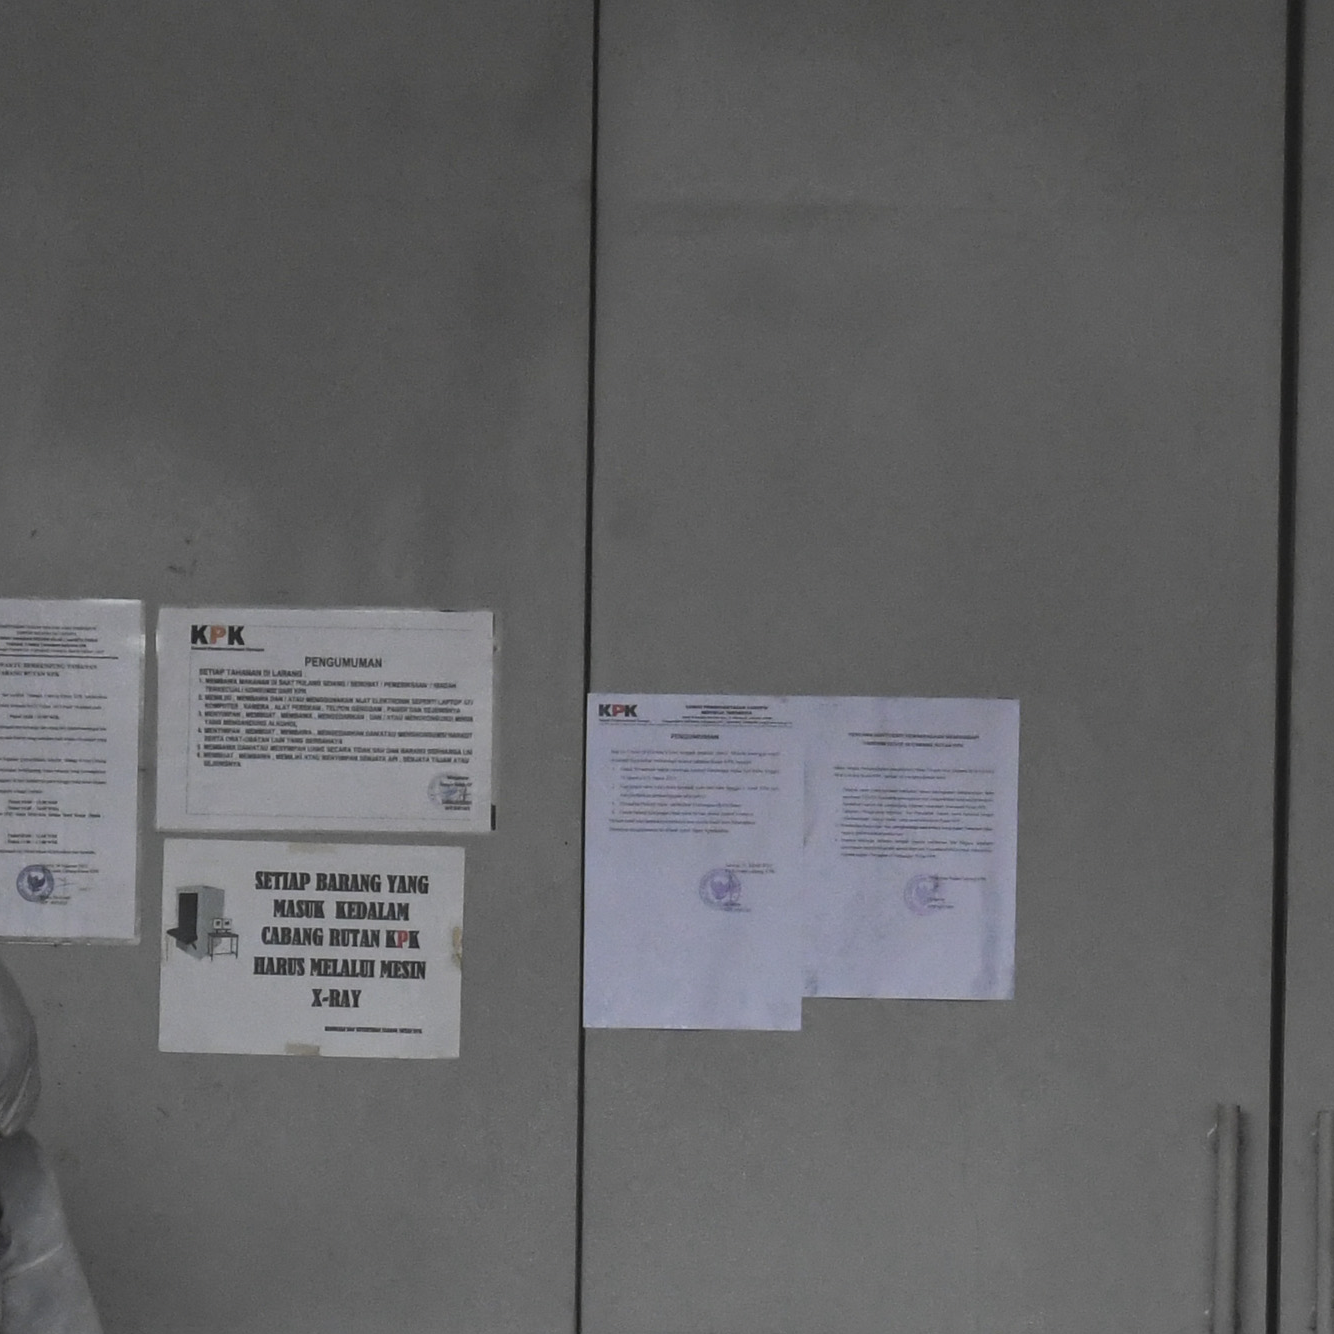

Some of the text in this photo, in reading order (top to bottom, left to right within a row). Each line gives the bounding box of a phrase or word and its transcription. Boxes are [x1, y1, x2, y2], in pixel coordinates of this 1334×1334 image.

[191, 625, 245, 645] KPK
[305, 656, 382, 668] PENGUMUMAN
[599, 704, 637, 717] KPK
[255, 871, 429, 894] SETIAP BARANG YANG
[273, 899, 410, 921] MASUK KEDALAM
[261, 926, 421, 949] CABANG RUTAN KPK
[253, 957, 426, 980] HARUS MELALUI MESIN
[311, 988, 362, 1008] X-RAY
